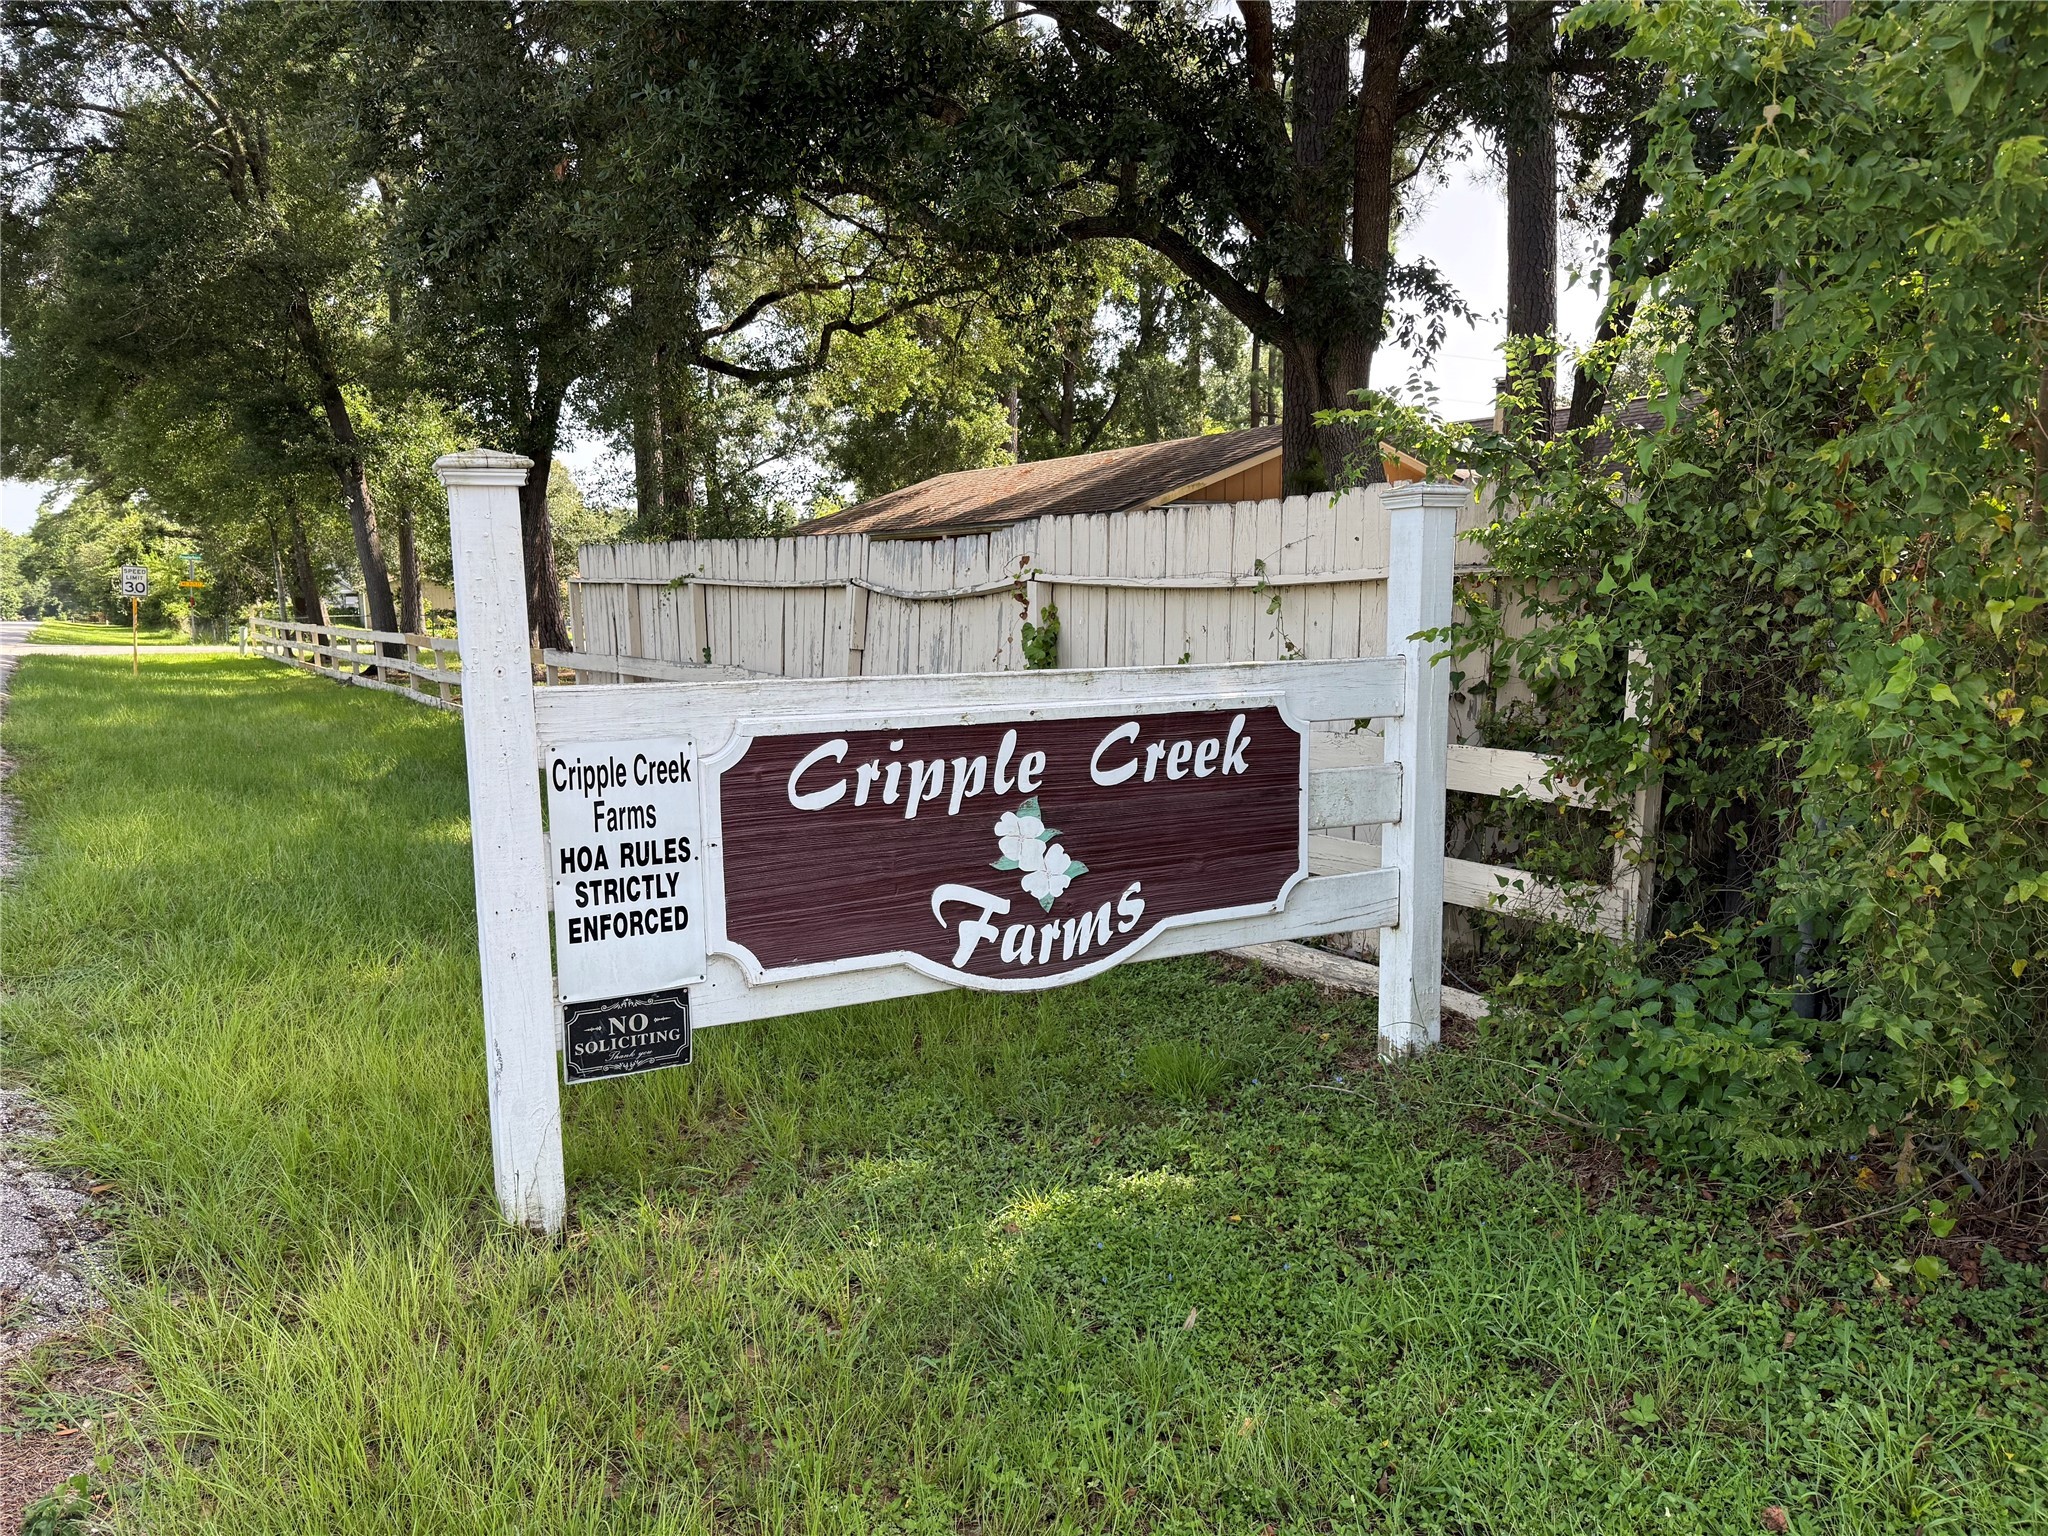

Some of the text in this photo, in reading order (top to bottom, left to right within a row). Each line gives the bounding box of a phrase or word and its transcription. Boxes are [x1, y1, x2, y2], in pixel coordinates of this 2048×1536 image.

[125, 582, 146, 593] 30
[552, 751, 692, 798] Cripple Creek
[787, 713, 1252, 820] Cripple Creek
[593, 800, 657, 833] Farms
[560, 836, 692, 874] HOA RULES
[575, 872, 681, 909] STRICTLY
[568, 905, 690, 945] ENFORCED
[930, 881, 1146, 969] Farms
[574, 1028, 681, 1056] SOLICITING
[608, 1013, 649, 1036] NO
[605, 1049, 653, 1062] Thank you
